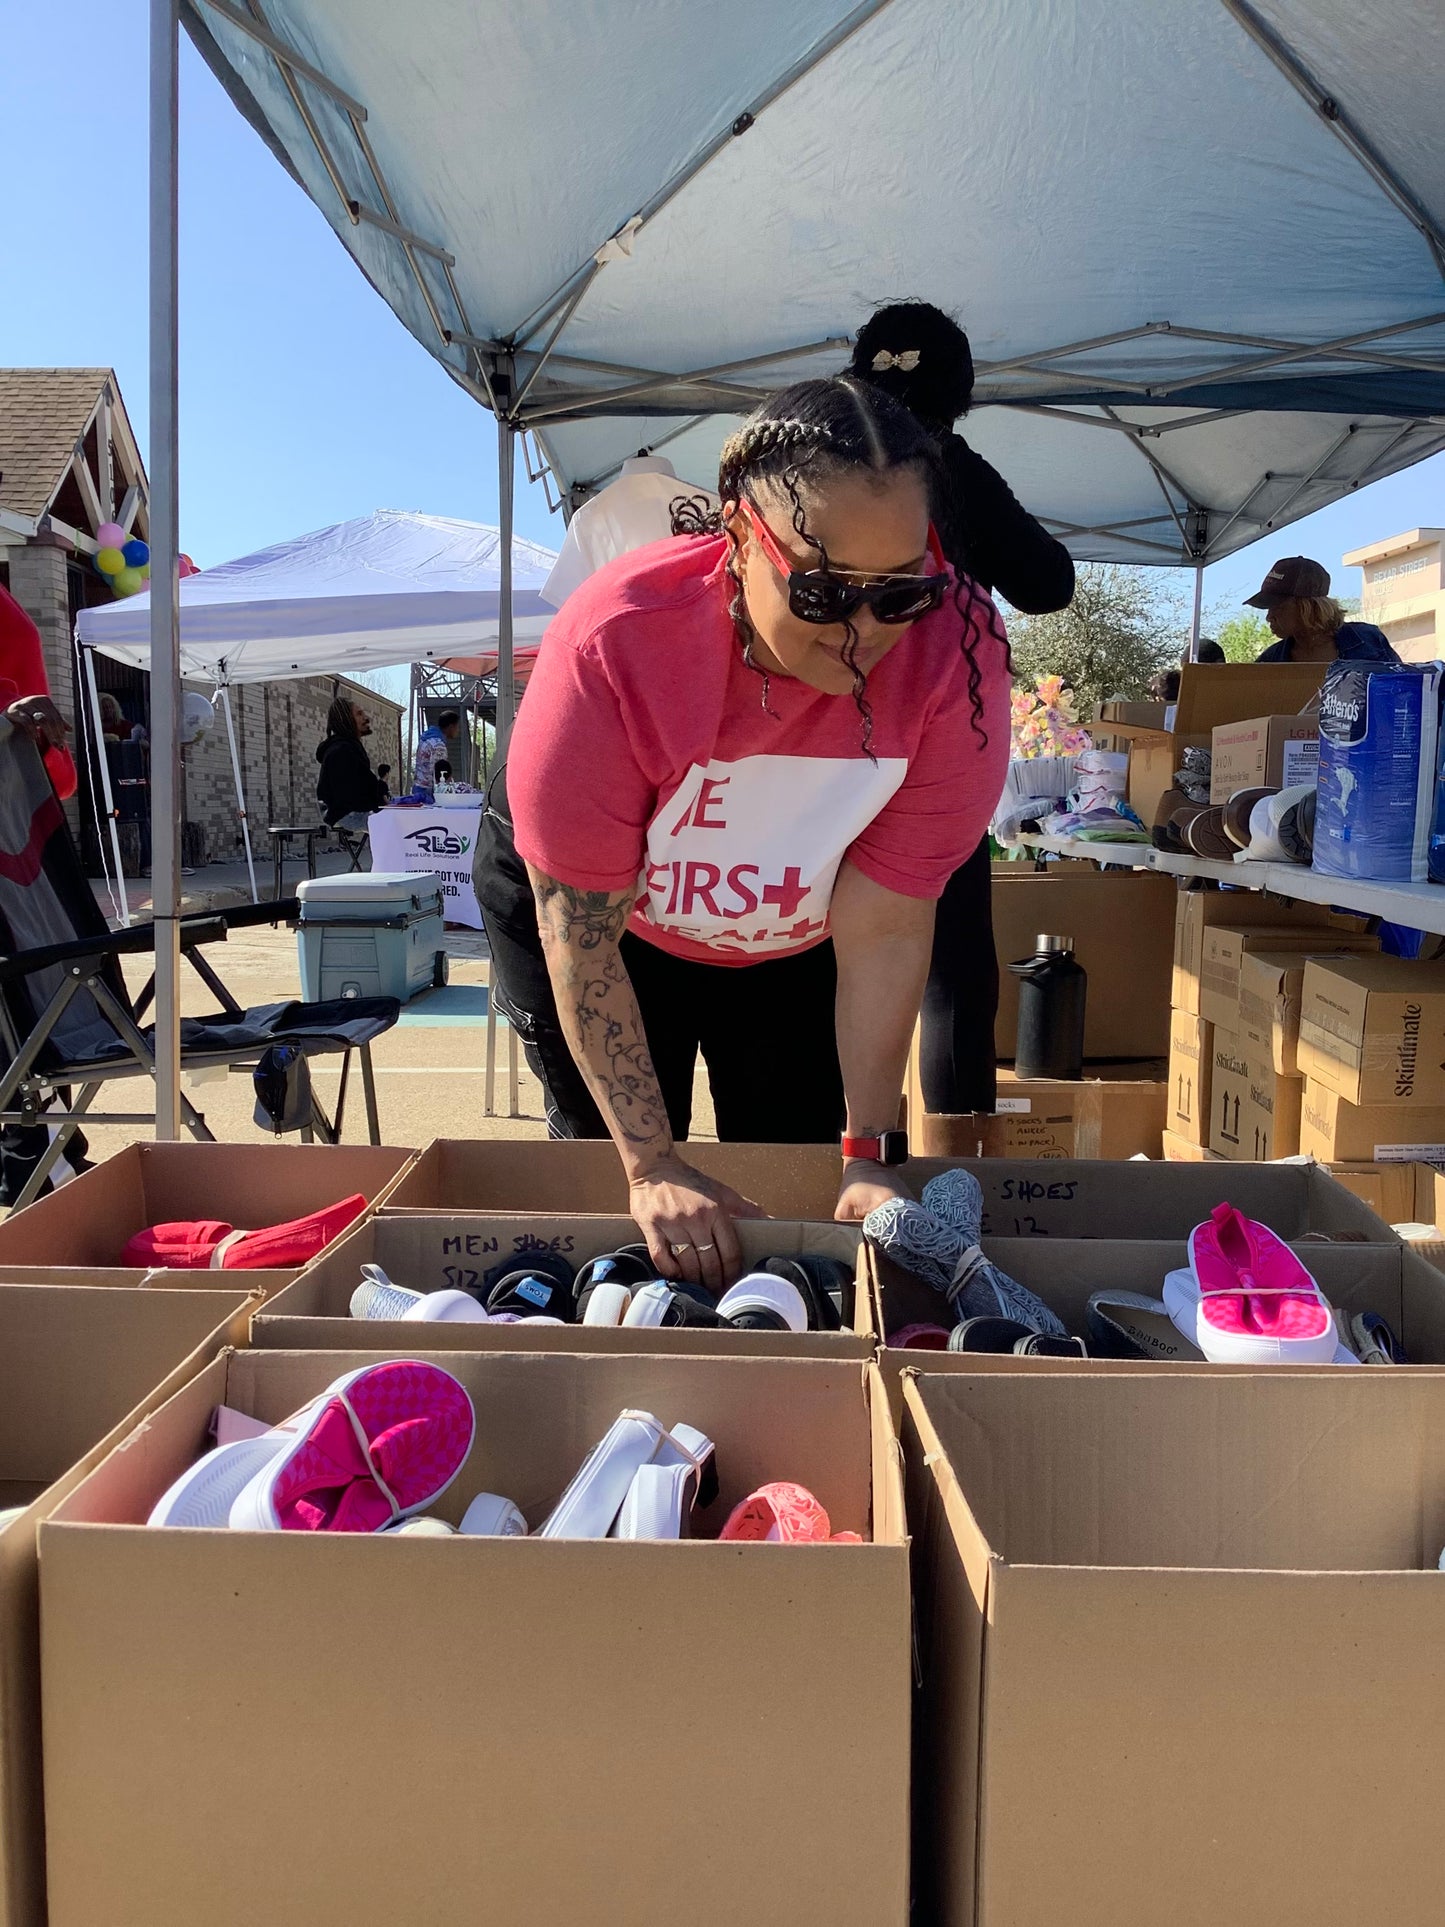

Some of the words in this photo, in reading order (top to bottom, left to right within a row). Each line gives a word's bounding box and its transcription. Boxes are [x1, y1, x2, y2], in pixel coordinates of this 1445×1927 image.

[1399, 557, 1428, 578] STREET
[1290, 729, 1305, 739] LG
[453, 871, 471, 884] YOU
[1393, 1003, 1422, 1097] Skintimate
[1001, 1179, 1078, 1203] SHOES
[1014, 1216, 1049, 1235] 12
[442, 1234, 498, 1256] MEN
[513, 1234, 575, 1253] SHOES
[525, 1284, 544, 1299] TOMS
